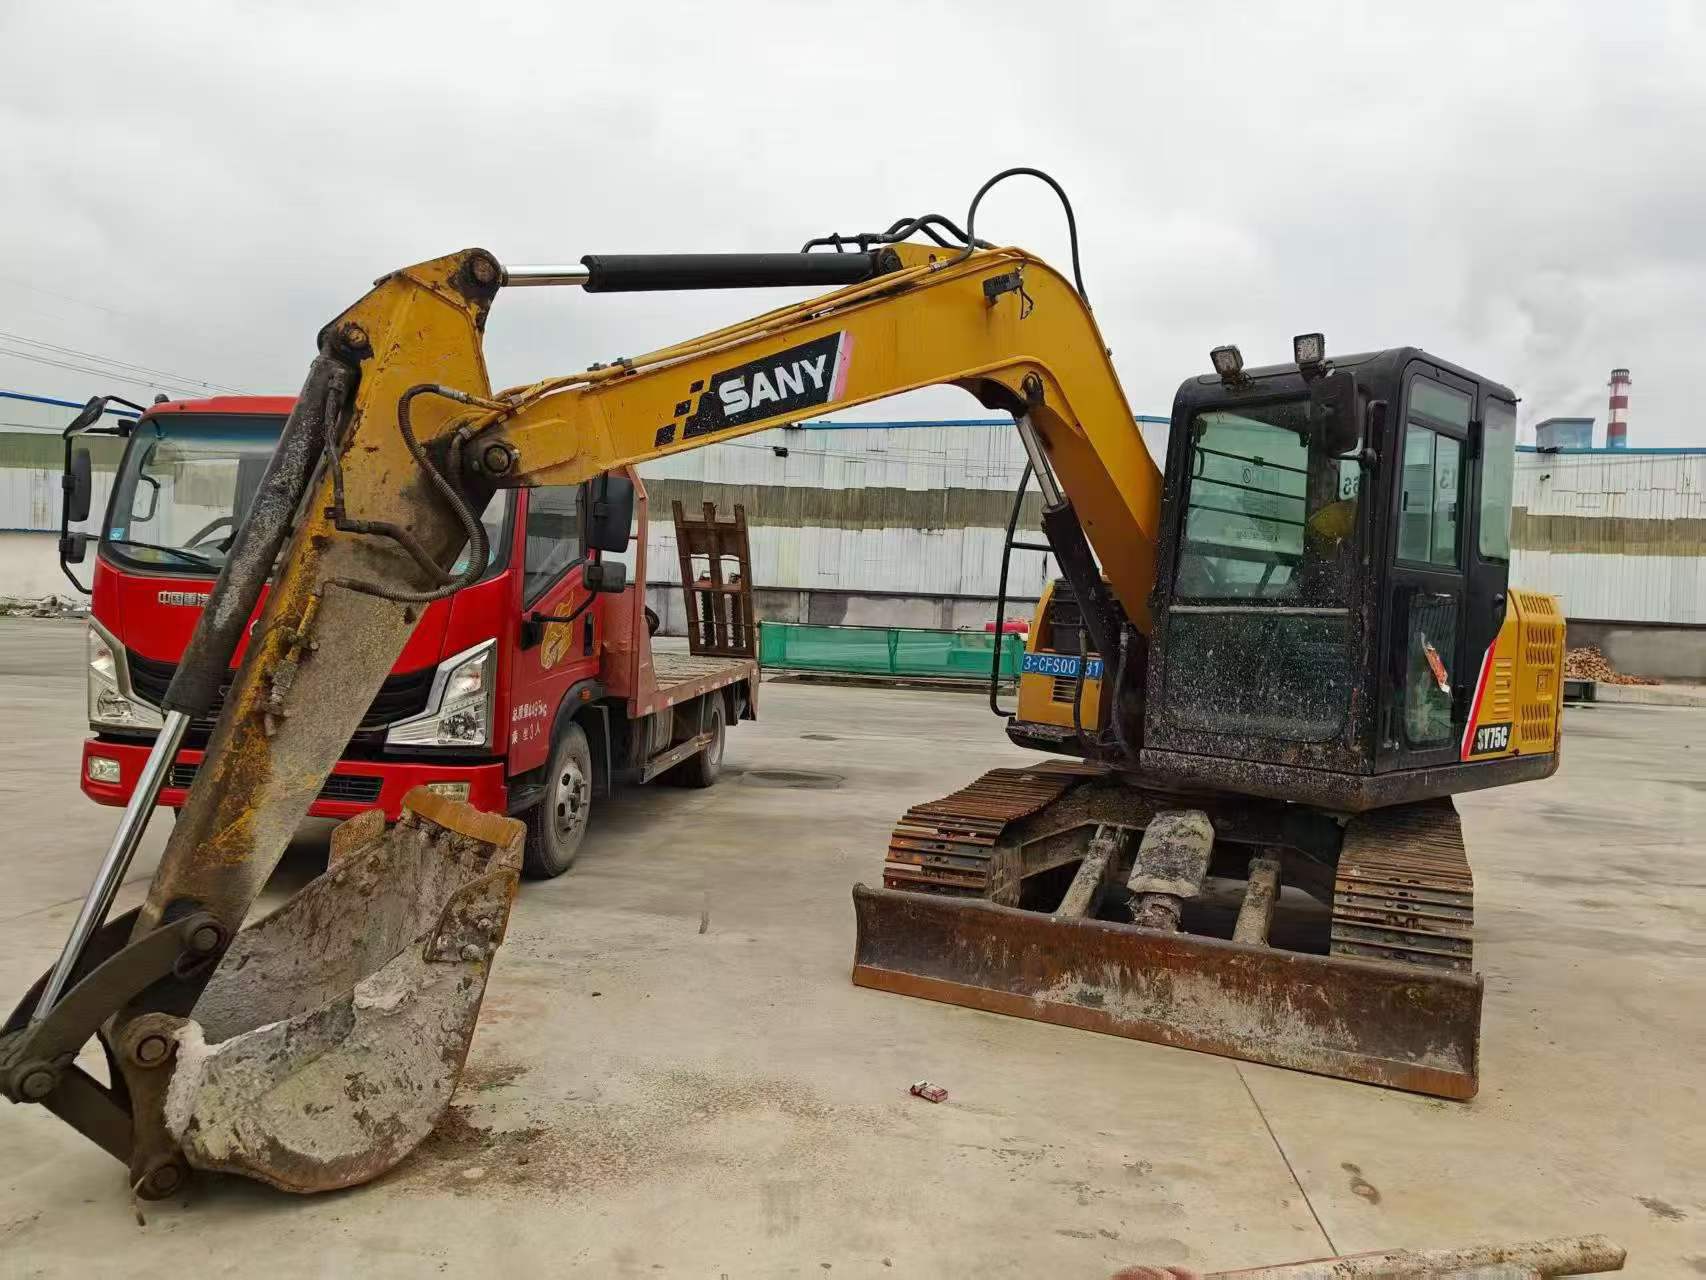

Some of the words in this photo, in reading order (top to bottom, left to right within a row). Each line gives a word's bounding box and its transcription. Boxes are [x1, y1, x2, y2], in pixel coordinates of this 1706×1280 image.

[719, 354, 826, 417] SANY
[1023, 656, 1100, 677] 3-CFS0031
[1477, 726, 1508, 750] SY75C
